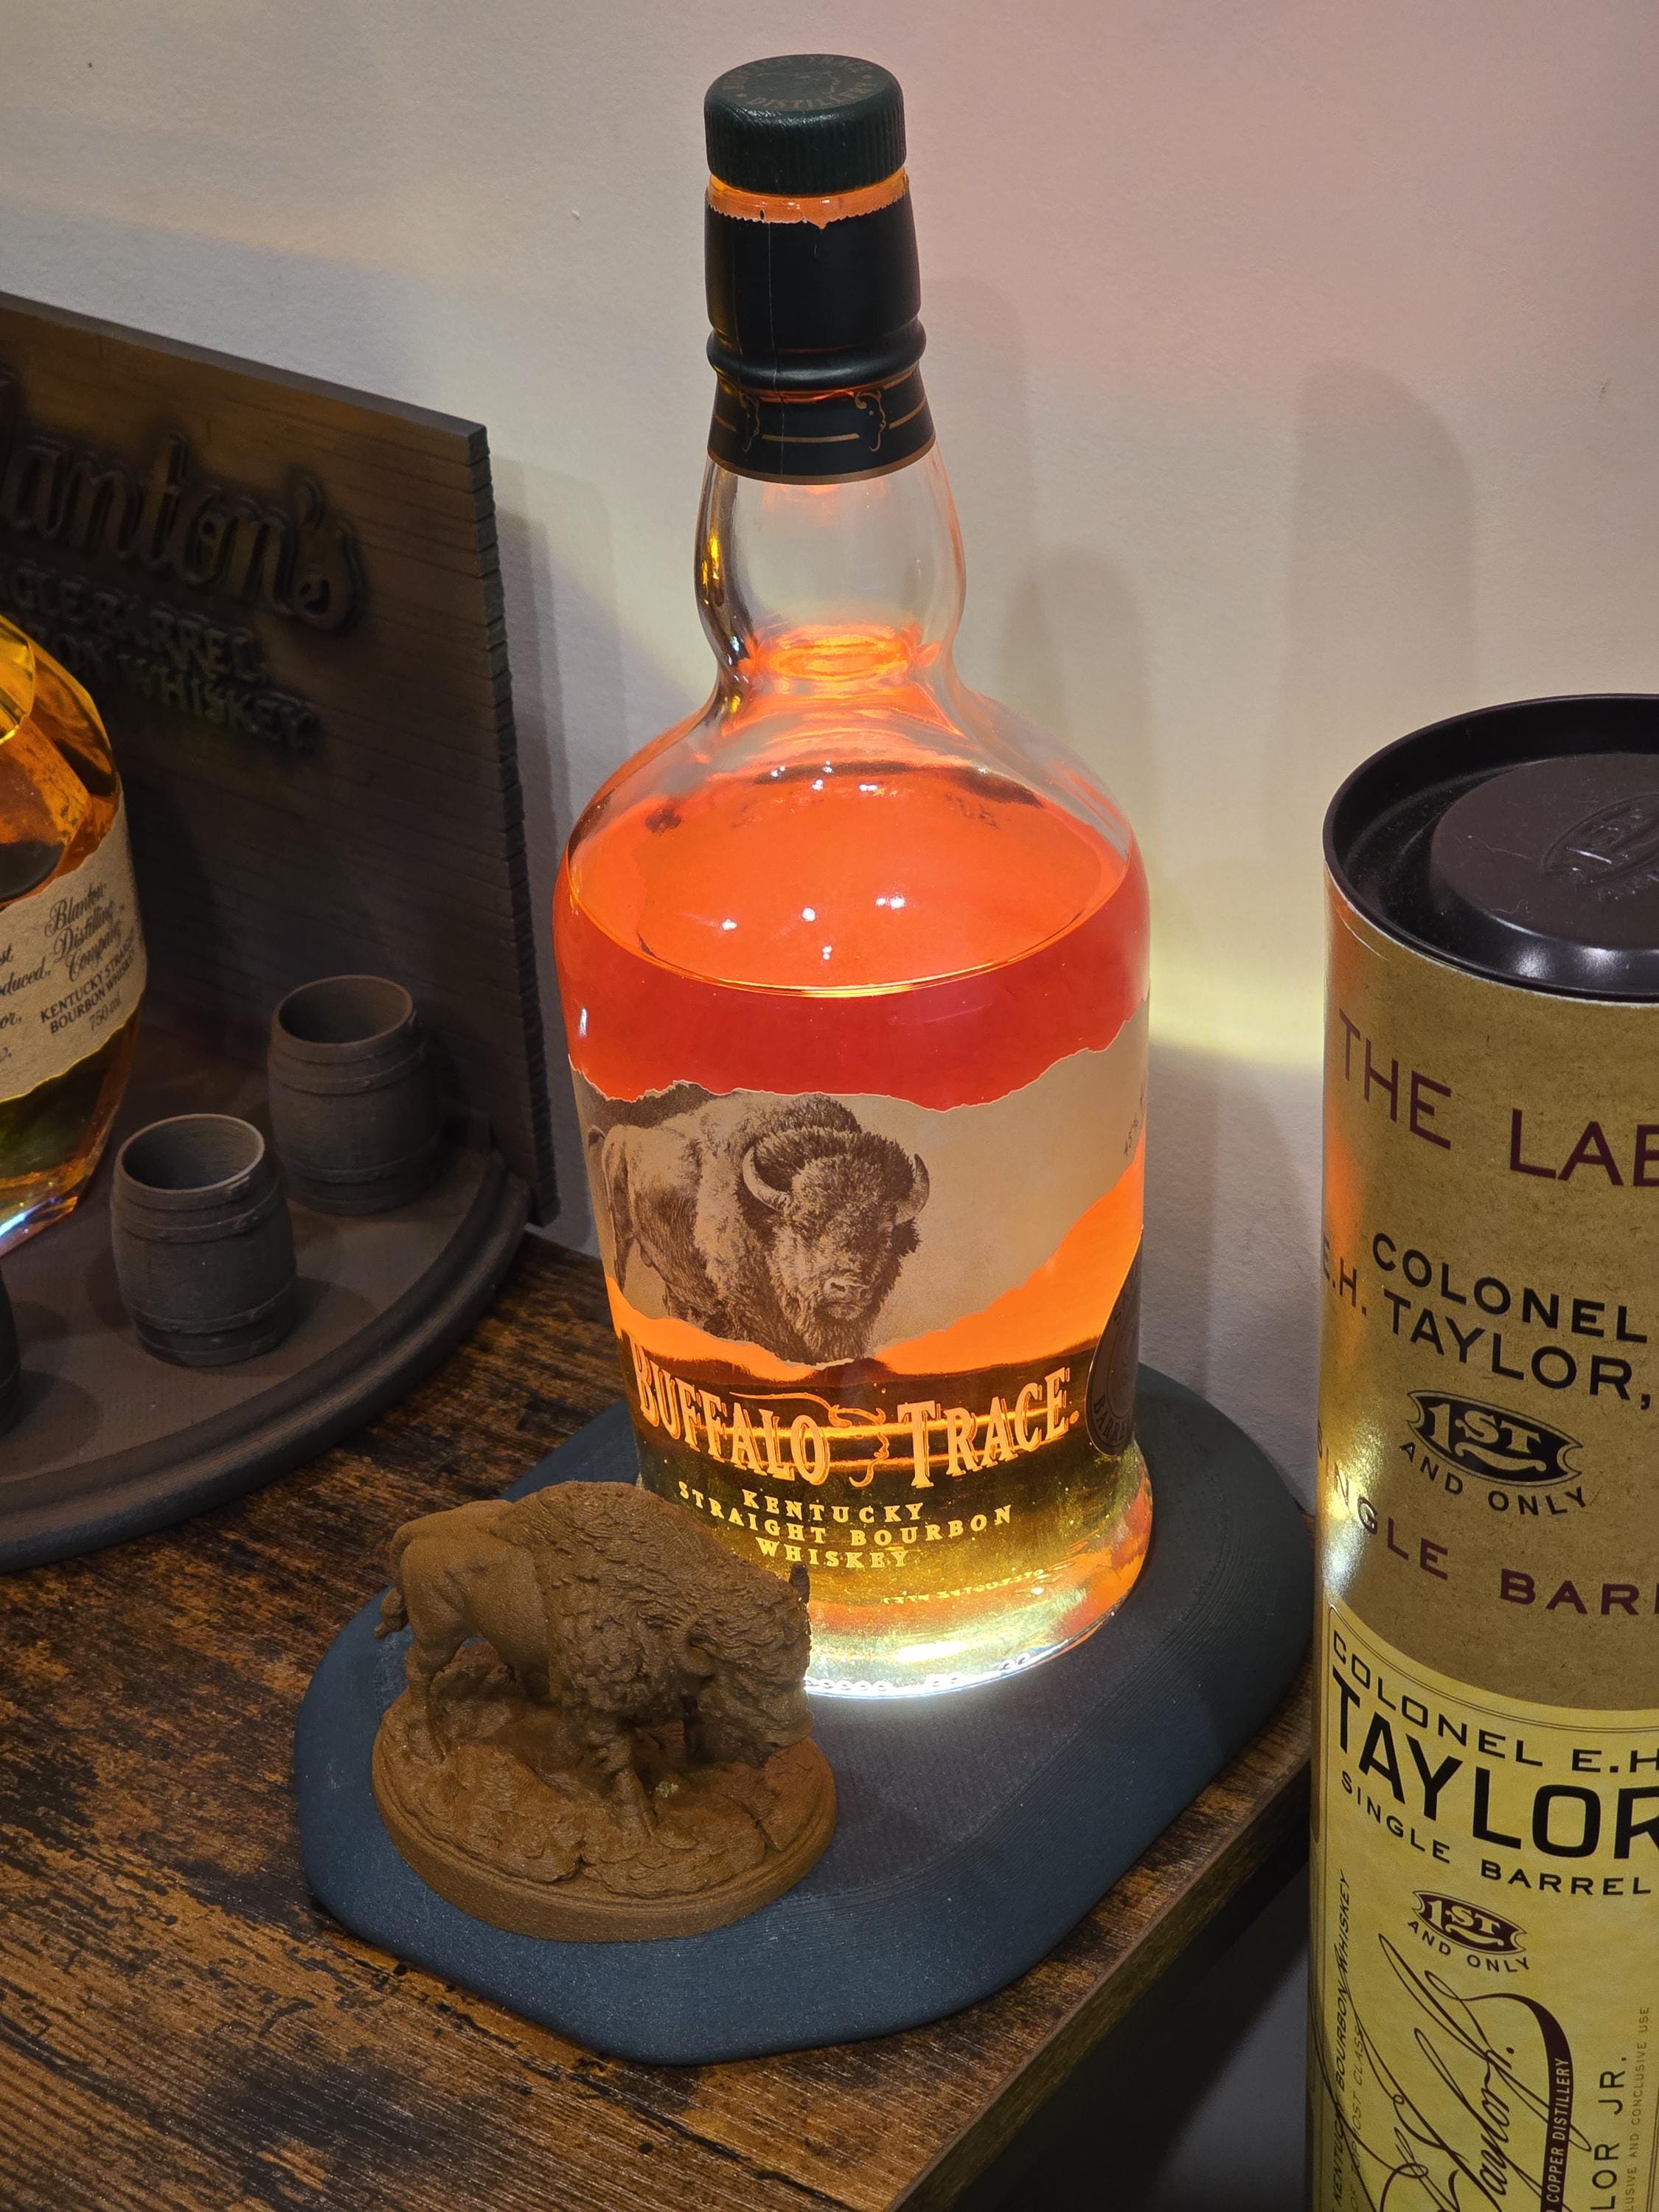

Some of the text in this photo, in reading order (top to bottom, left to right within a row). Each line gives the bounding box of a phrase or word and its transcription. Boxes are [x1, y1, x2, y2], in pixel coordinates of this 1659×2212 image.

[0, 376, 371, 633] anton's
[40, 970, 104, 1023] KENTUCKY
[49, 989, 105, 1034] BOURBON
[1339, 1007, 1451, 1150] THE
[1372, 1233, 1647, 1343] COLONEL
[1383, 1289, 1650, 1410] TAYLOR,
[627, 1331, 831, 1485] BUFFALO
[678, 1481, 1012, 1547] STRAIGHT BOURBON
[742, 1489, 924, 1524] KENTUCKY
[1400, 1442, 1587, 1516] AND ONLY
[755, 1537, 909, 1568] WHISKEY
[1501, 1568, 1659, 1615] BAR
[1333, 1630, 1543, 1767] COLONEL
[1332, 1664, 1659, 1860] TAYLOR
[1341, 1770, 1652, 1895] SINGLE BARREL
[1336, 1869, 1351, 1972] WHISKEY
[1408, 1919, 1530, 1973] AND ONLY
[1335, 1981, 1349, 2091] BOURBON
[1353, 2025, 1365, 2086] CLASS
[1638, 2006, 1649, 2033] USE
[1598, 2056, 1627, 2115] JR.
[1631, 2041, 1647, 2125] CONCLUSIVE
[1350, 2091, 1362, 2175] TOPOST
[1546, 2058, 1569, 2203] COPPER DISTILLERY
[1627, 2133, 1639, 2157] AND
